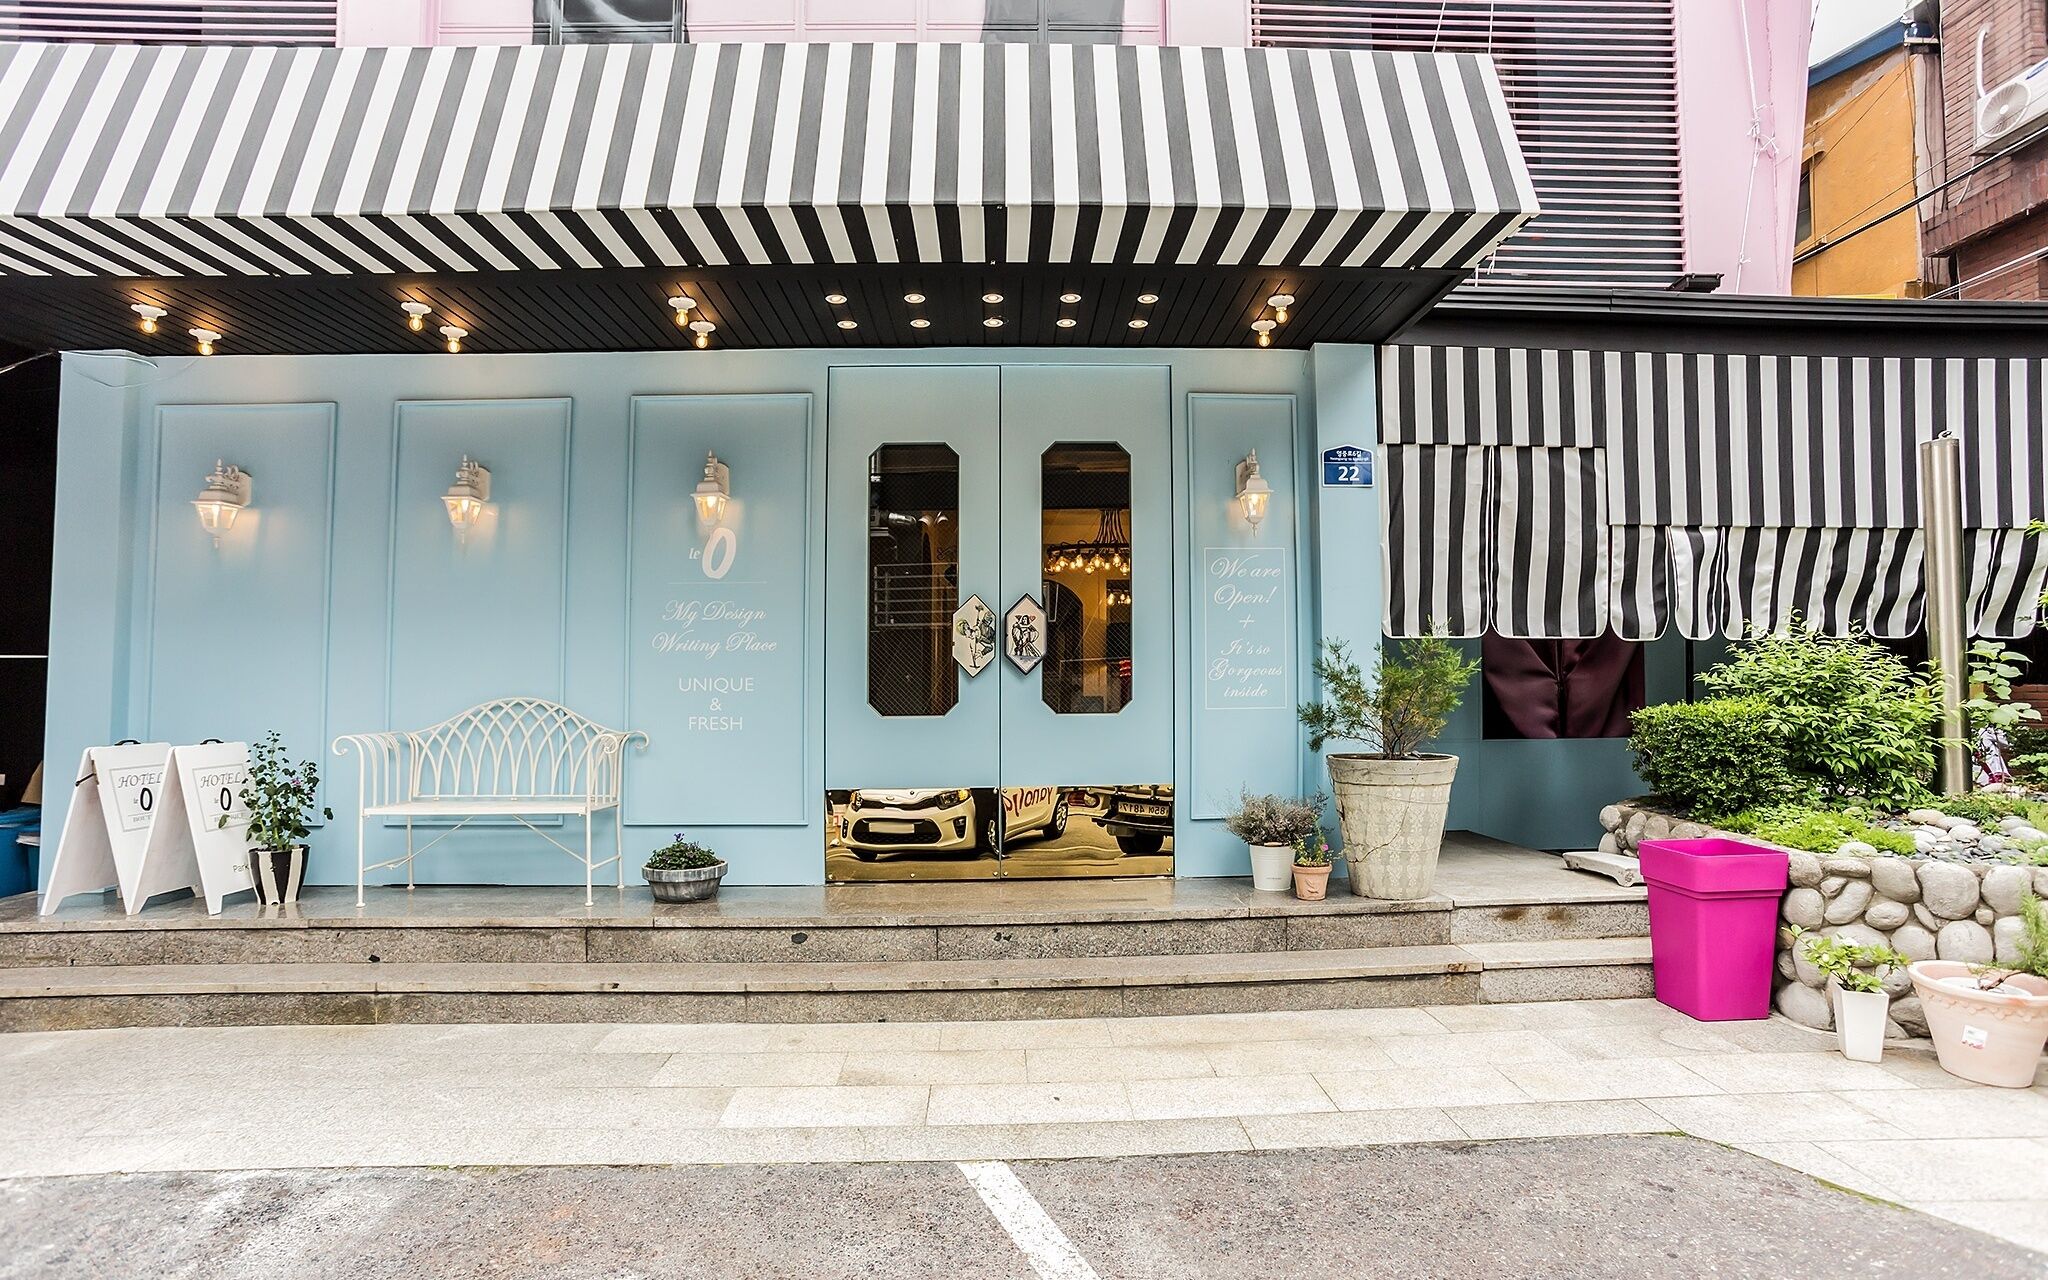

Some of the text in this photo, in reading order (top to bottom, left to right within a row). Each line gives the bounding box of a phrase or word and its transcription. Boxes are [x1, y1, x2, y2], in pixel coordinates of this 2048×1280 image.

[1338, 466, 1360, 481] 22
[1210, 554, 1281, 579] We are
[1214, 584, 1277, 611] Open!
[662, 600, 767, 628] My Design
[651, 629, 777, 660] Writing Place
[1221, 639, 1270, 655] It's so
[1208, 657, 1283, 683] Gorgeous
[678, 677, 754, 694] UNIQUE
[1223, 683, 1269, 698] inside
[709, 698, 722, 711] &
[688, 716, 743, 730] FRESH
[118, 772, 163, 788] HOTEL
[200, 771, 241, 788] HOTEL
